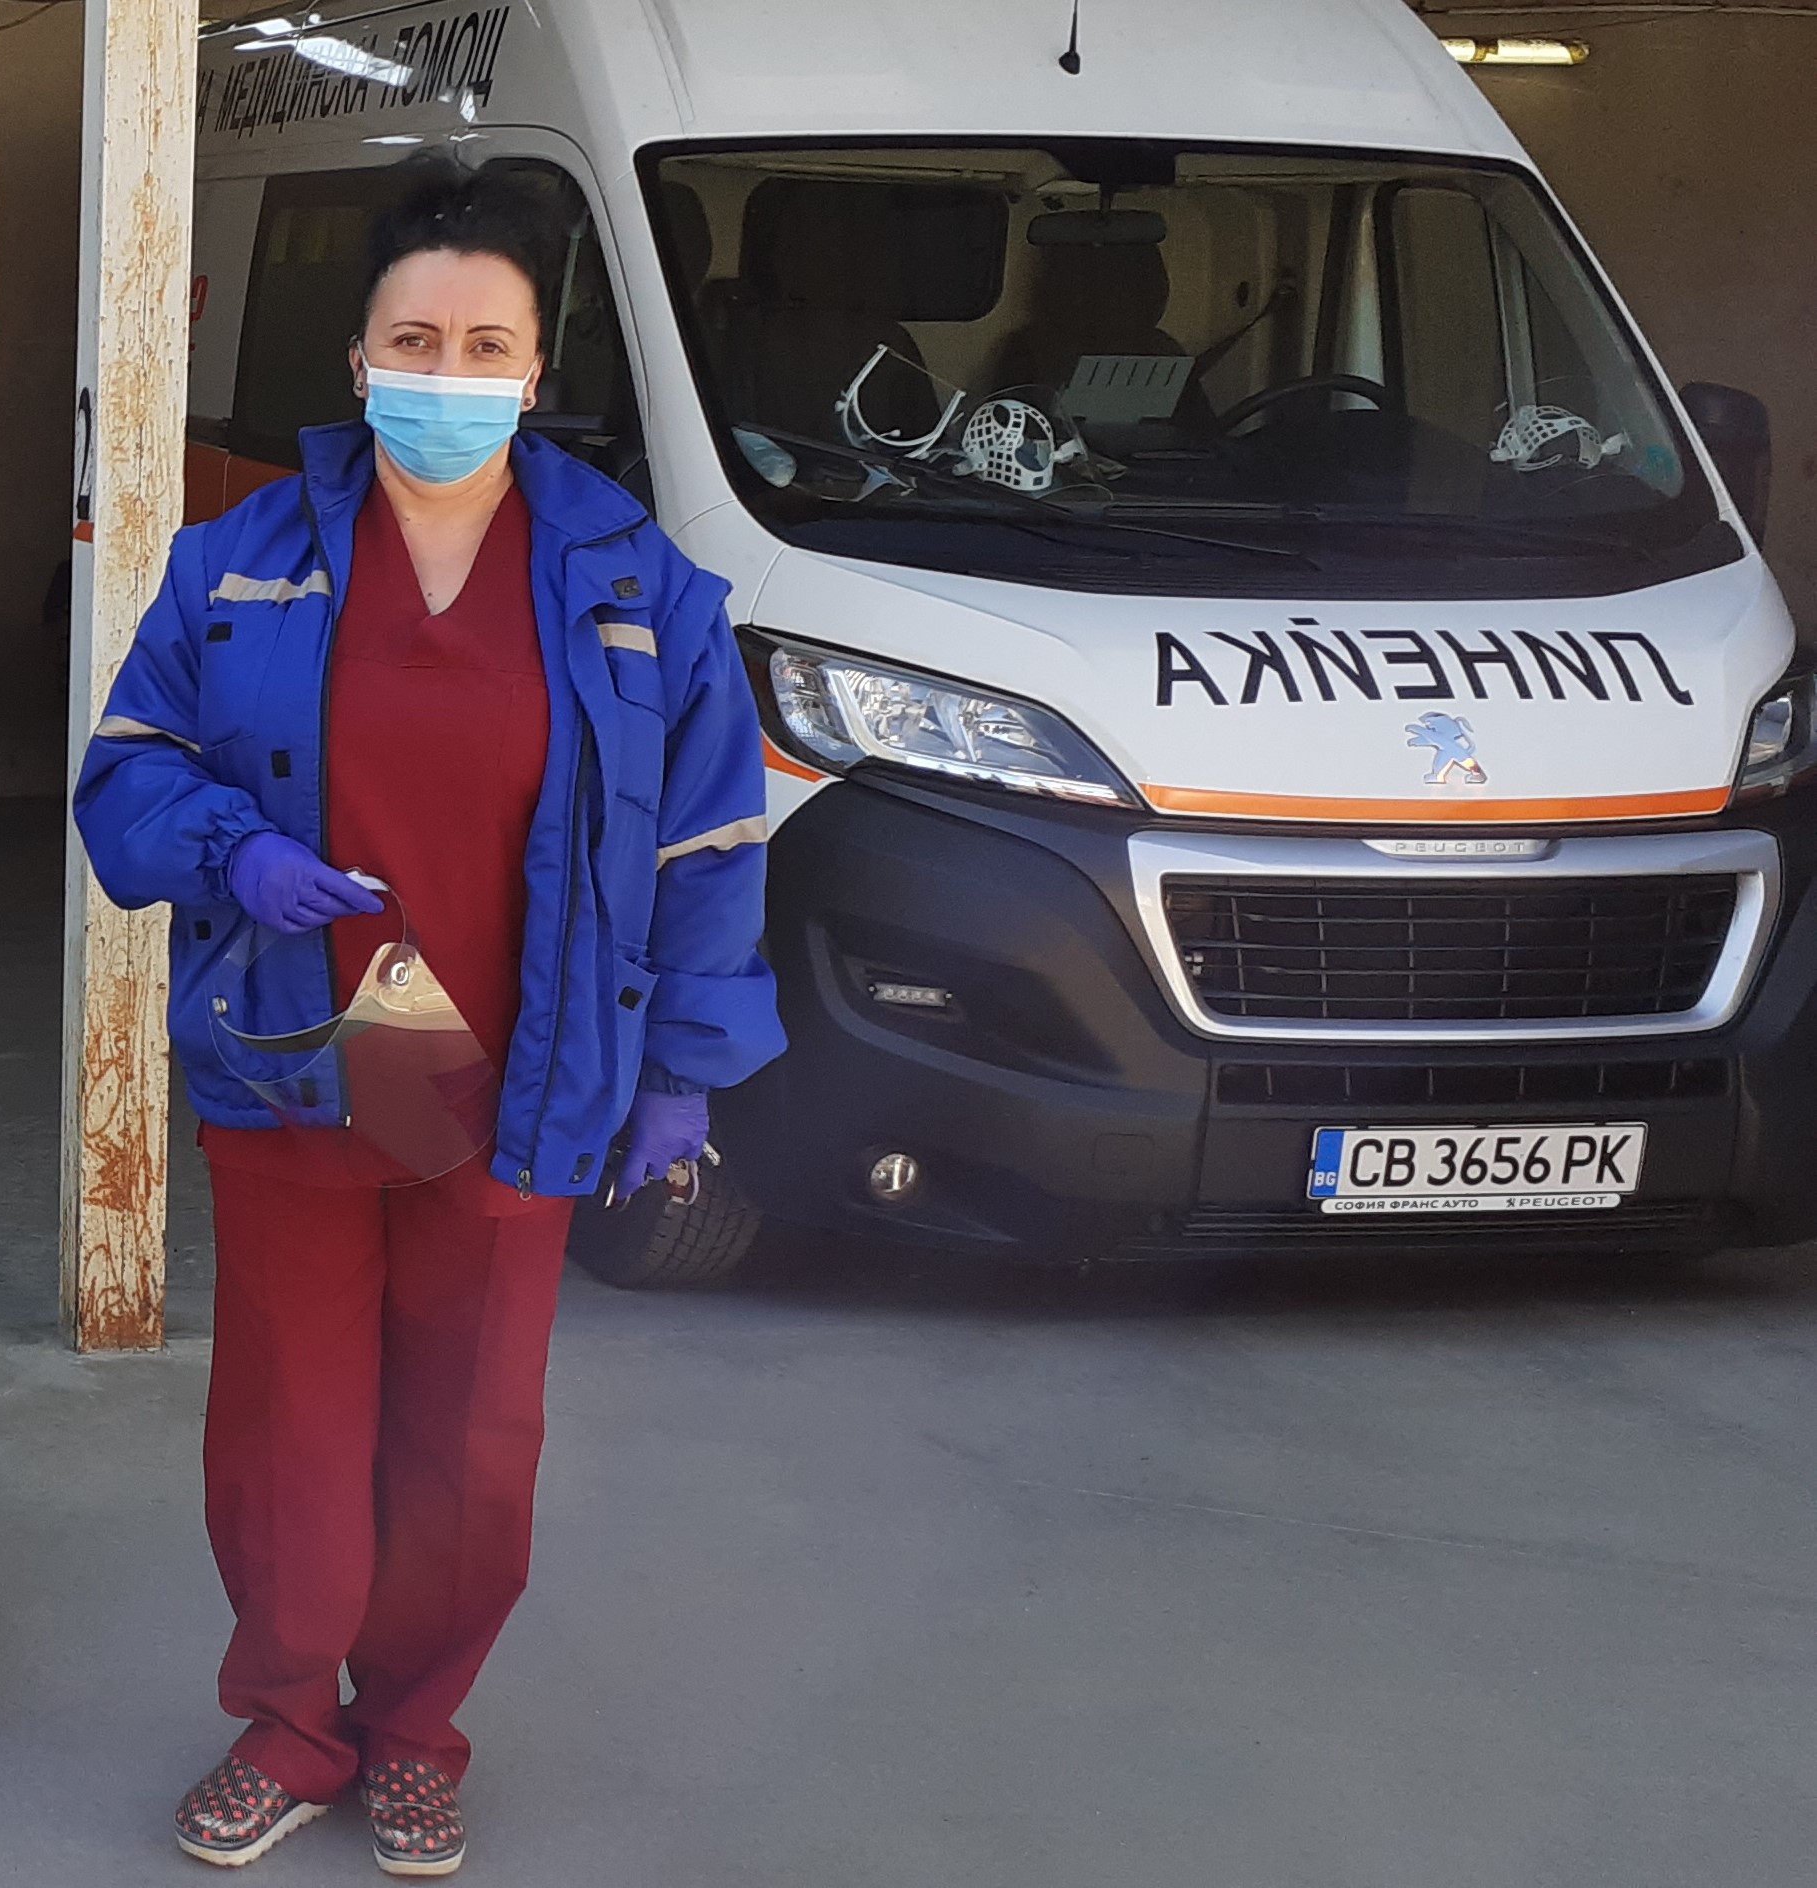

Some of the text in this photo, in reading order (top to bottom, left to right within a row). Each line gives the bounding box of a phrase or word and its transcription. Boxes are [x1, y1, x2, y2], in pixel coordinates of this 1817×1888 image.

[379, 6, 510, 108] ПОМОЩ
[1395, 842, 1524, 853] PEUGEOT
[1349, 1134, 1632, 1187] CB 3656 PK
[1314, 1172, 1337, 1186] BG
[1334, 1199, 1479, 1211] СОФИЯ ФРАНС АУТО
[1520, 1196, 1607, 1208] PEUGEOT
